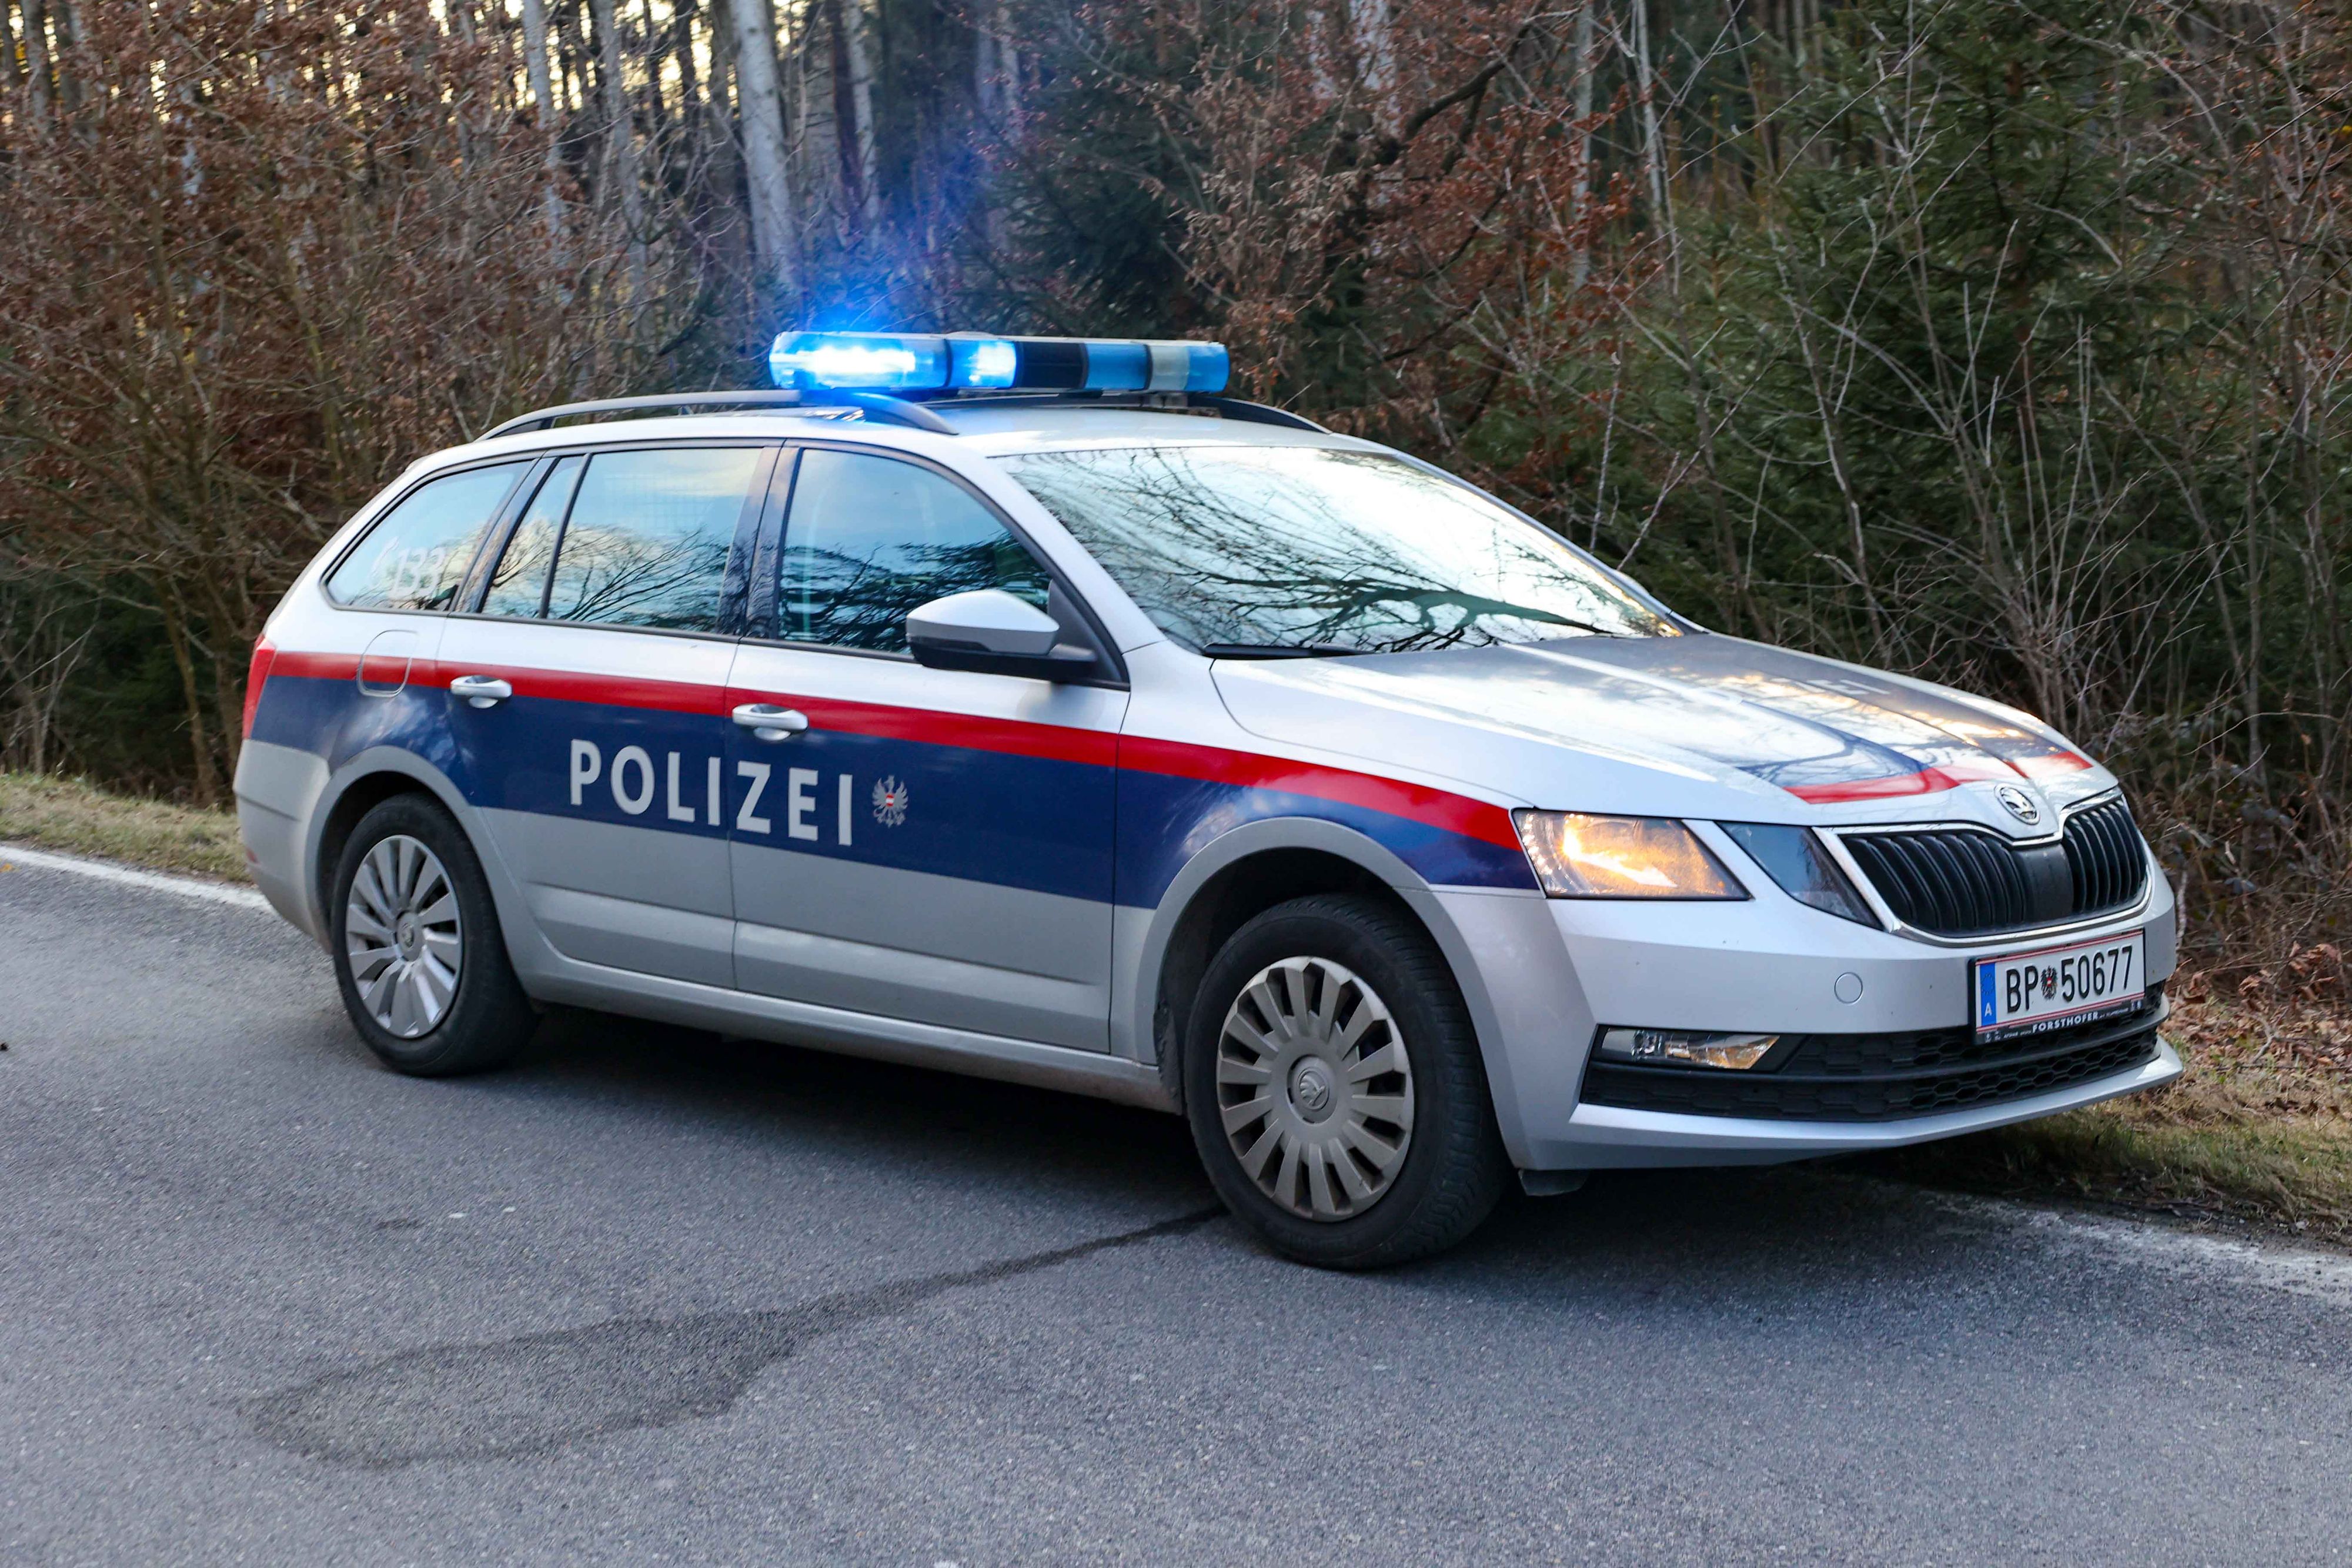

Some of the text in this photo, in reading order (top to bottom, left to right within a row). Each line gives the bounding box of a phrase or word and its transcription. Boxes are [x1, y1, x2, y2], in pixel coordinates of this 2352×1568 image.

[388, 546, 447, 599] 133
[570, 738, 852, 846] POLIZEI
[2006, 945, 2133, 1013] BP 50677
[1984, 1002, 1993, 1017] A
[2032, 1011, 2099, 1033] FORSTHOFER
